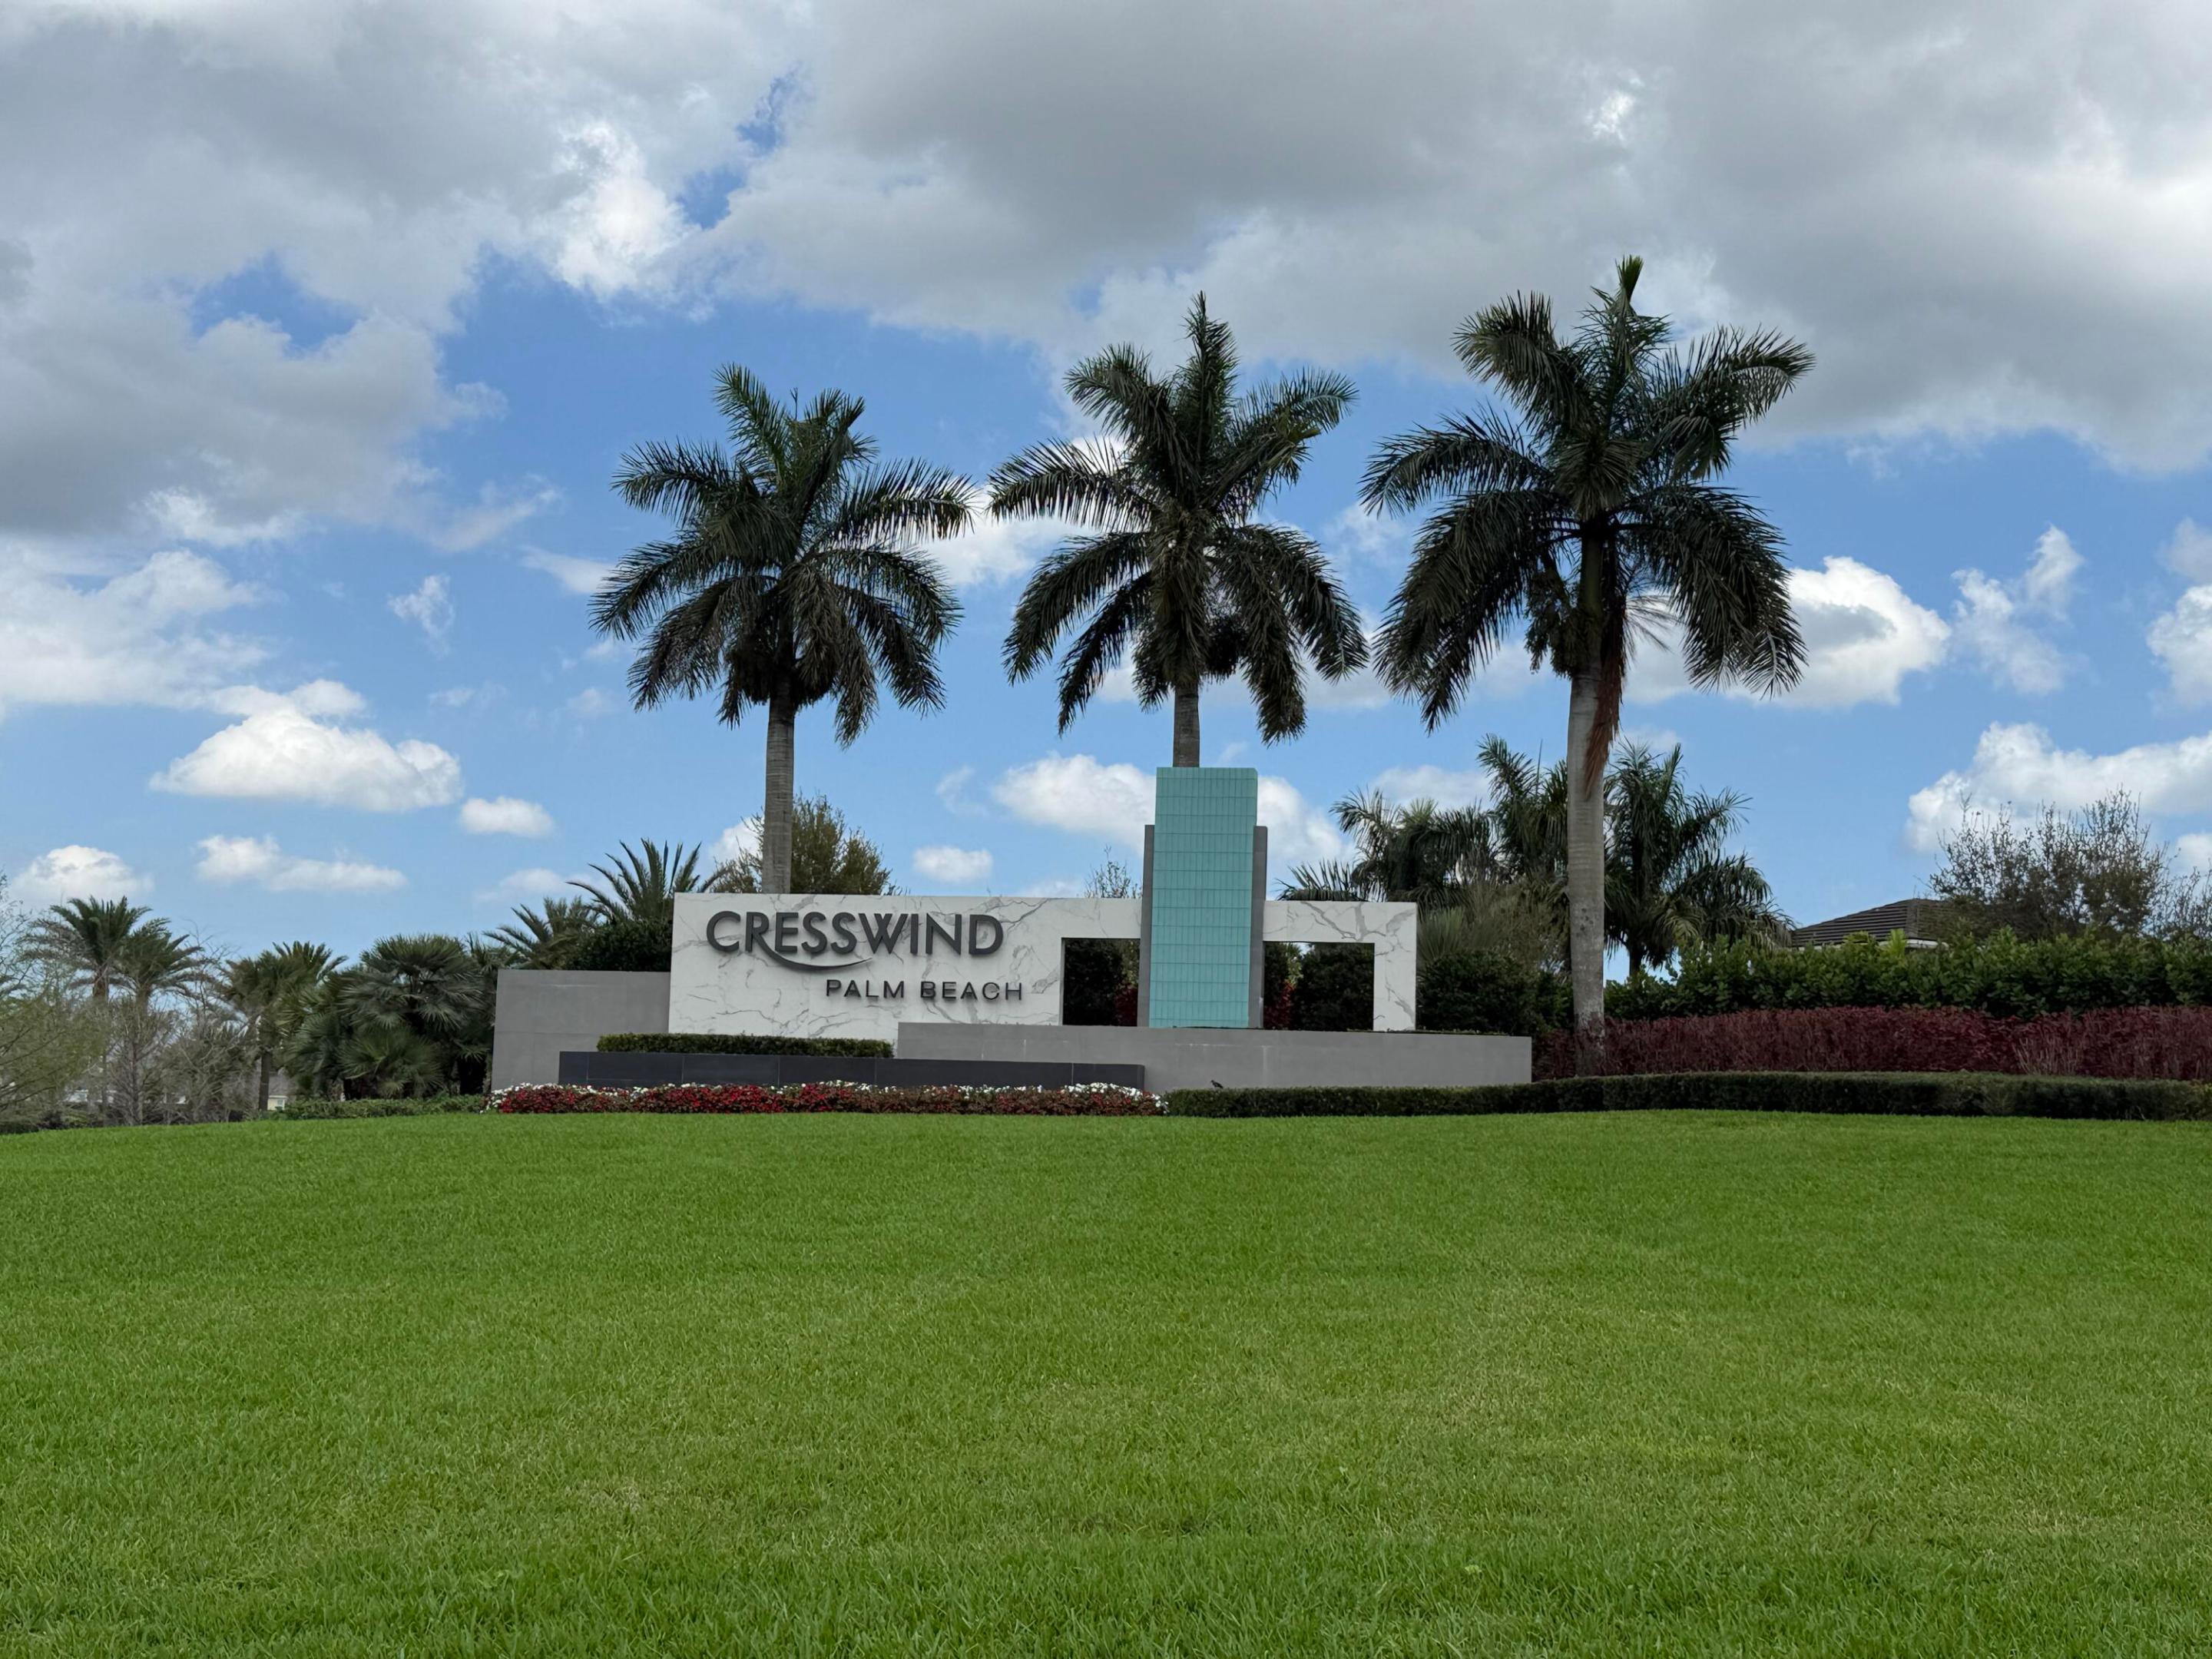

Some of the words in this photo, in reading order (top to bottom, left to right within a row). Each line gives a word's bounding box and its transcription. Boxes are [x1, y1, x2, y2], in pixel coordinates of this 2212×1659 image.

[706, 910, 1004, 971] CRESSWIND
[826, 979, 905, 998] PALM
[921, 981, 1022, 1000] BEACH
